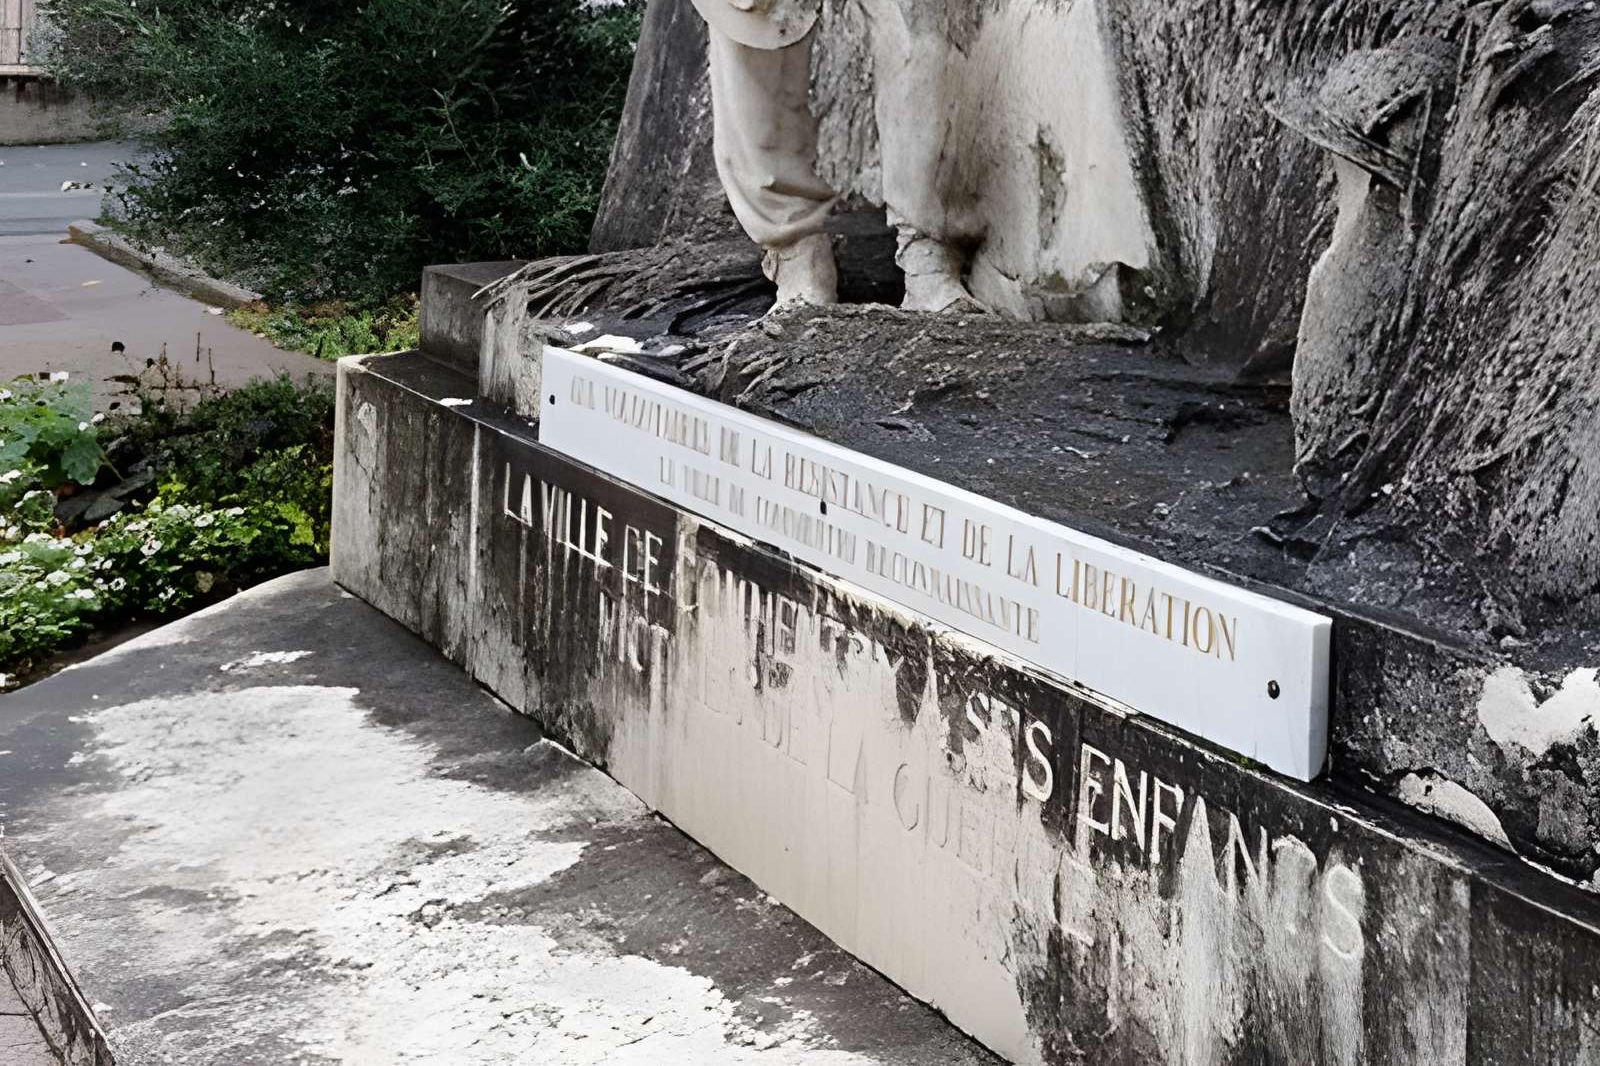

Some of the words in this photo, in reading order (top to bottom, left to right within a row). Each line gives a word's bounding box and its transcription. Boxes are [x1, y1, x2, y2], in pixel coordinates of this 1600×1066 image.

[503, 461, 533, 528] LA
[541, 479, 614, 569] VILLE
[621, 524, 664, 596] DE
[962, 517, 993, 567] DE
[1007, 534, 1039, 587] LA
[1055, 551, 1238, 663] LIBERATION
